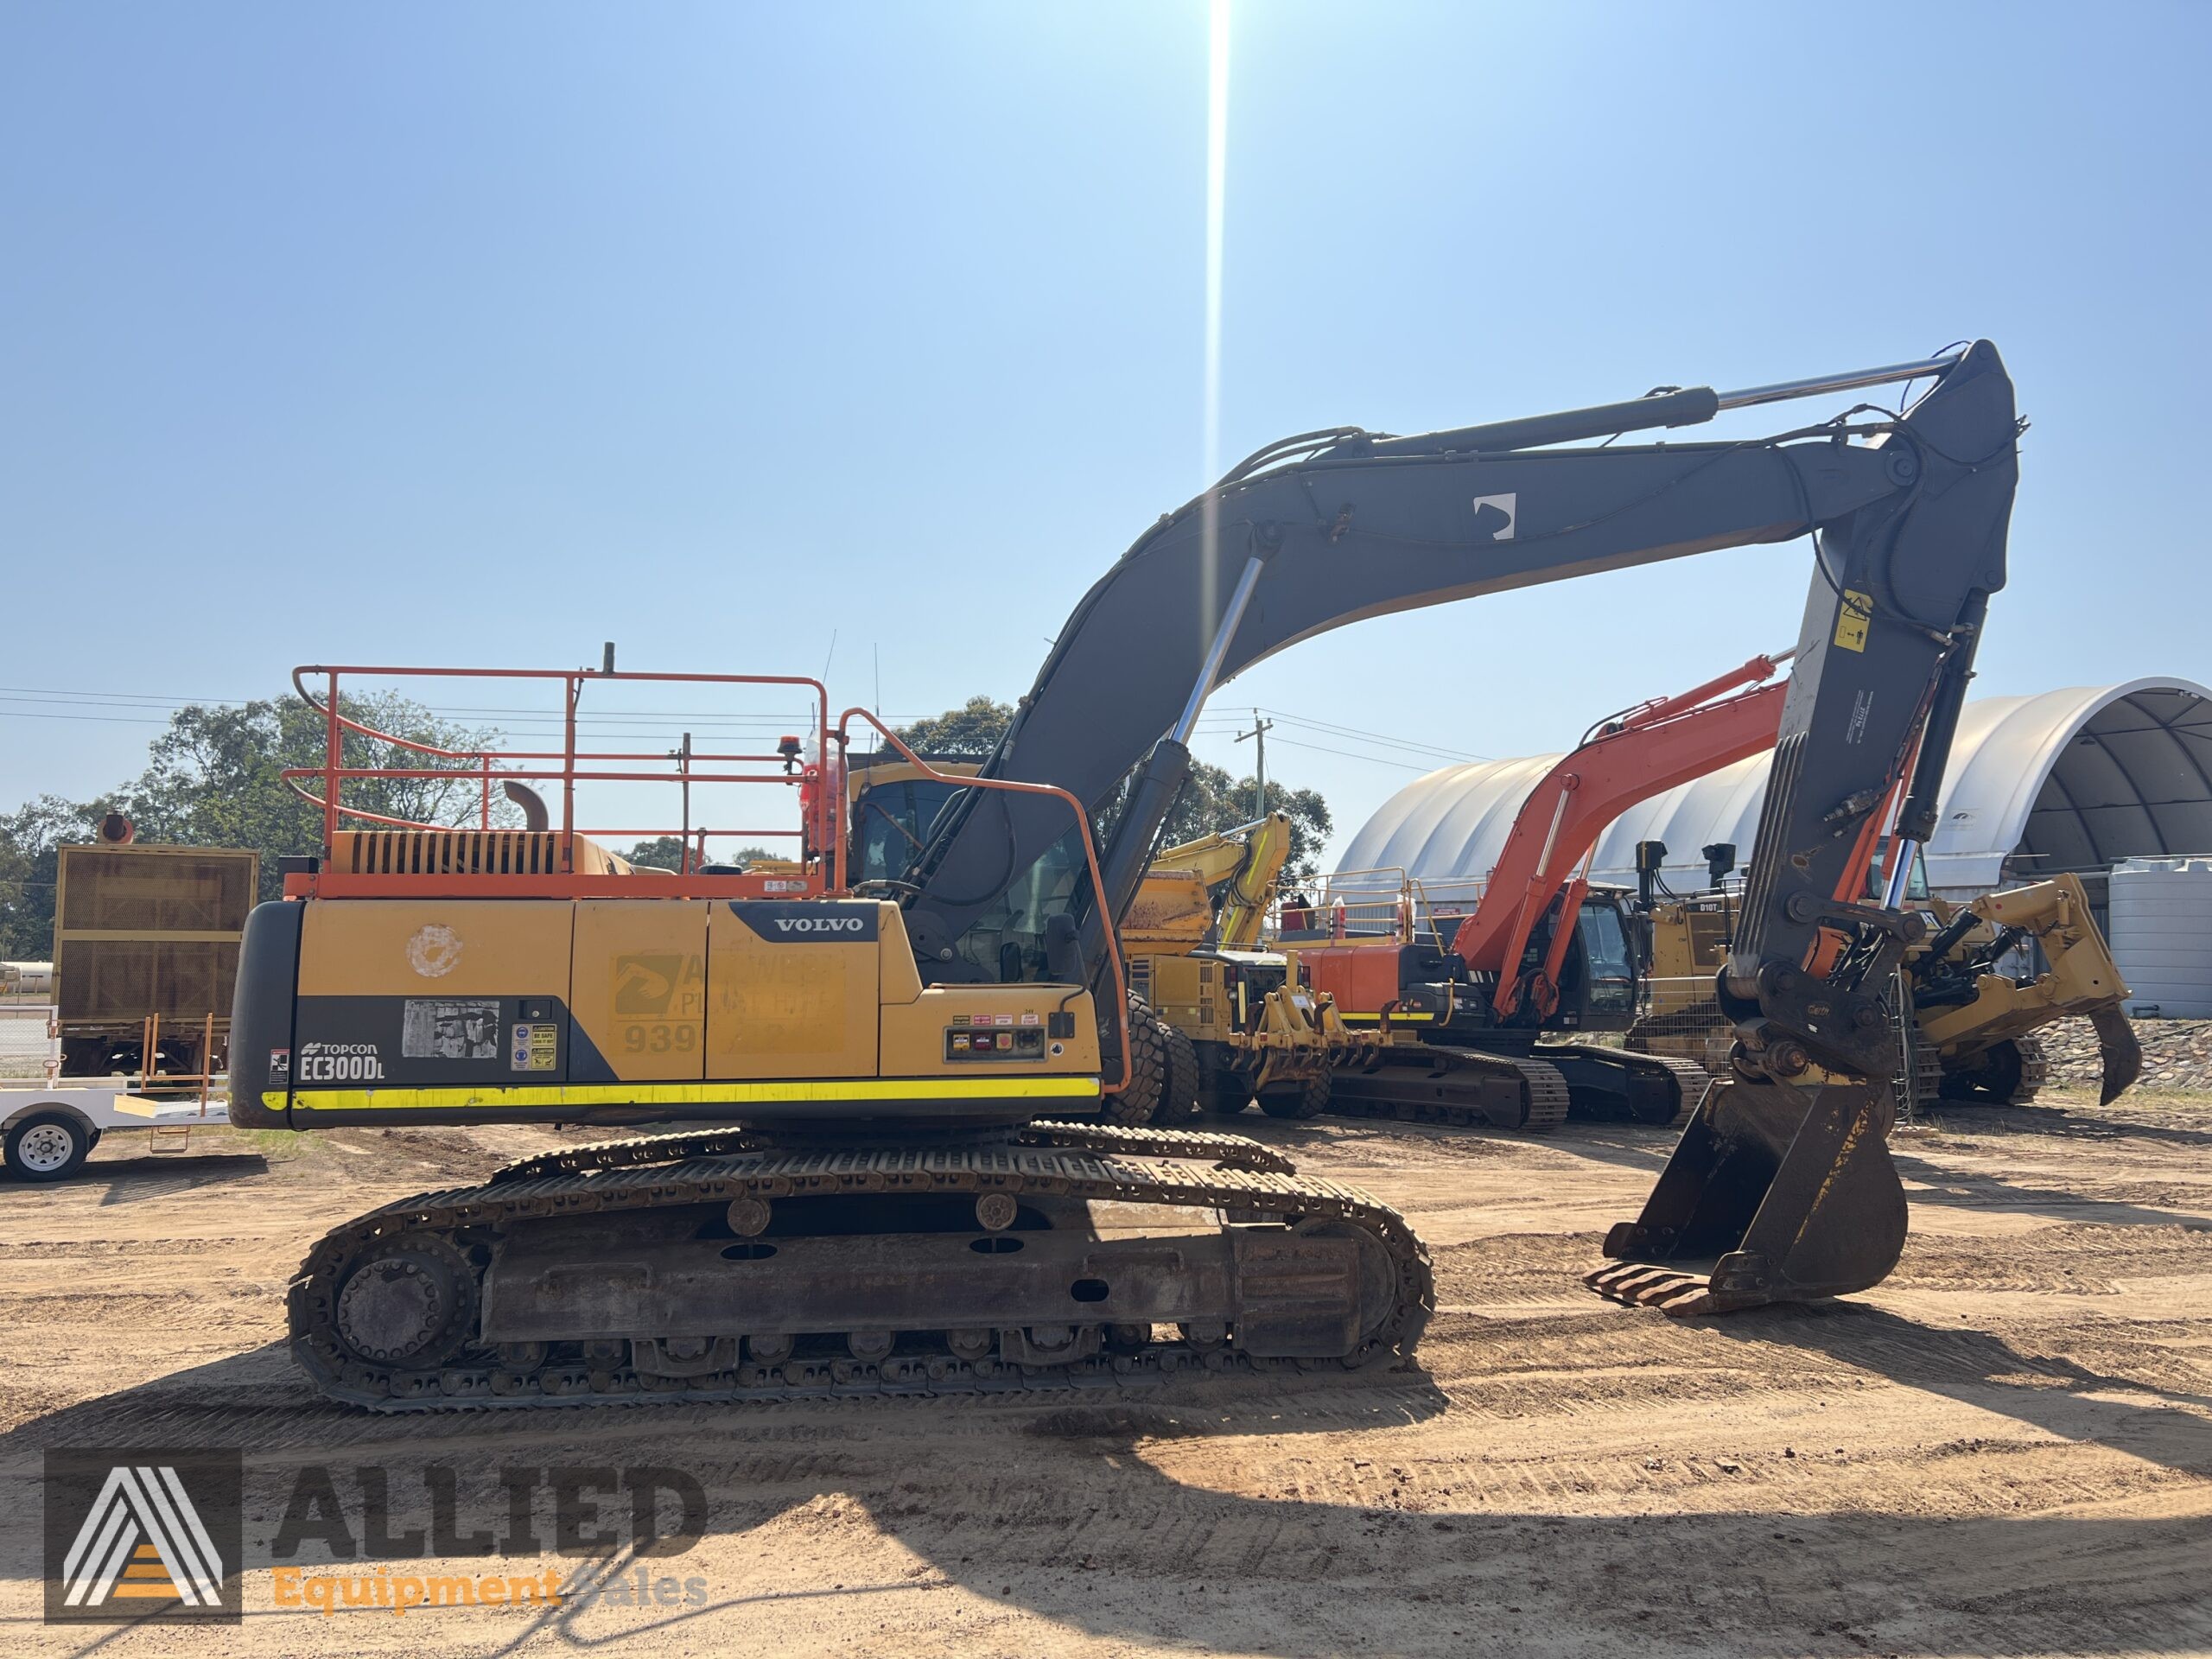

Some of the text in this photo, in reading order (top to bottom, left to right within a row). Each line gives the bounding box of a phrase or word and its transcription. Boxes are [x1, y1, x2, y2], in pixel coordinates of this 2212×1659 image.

[774, 918, 864, 931] VOLVO
[1920, 912, 1942, 931] AT
[301, 1056, 385, 1081] EC300DL
